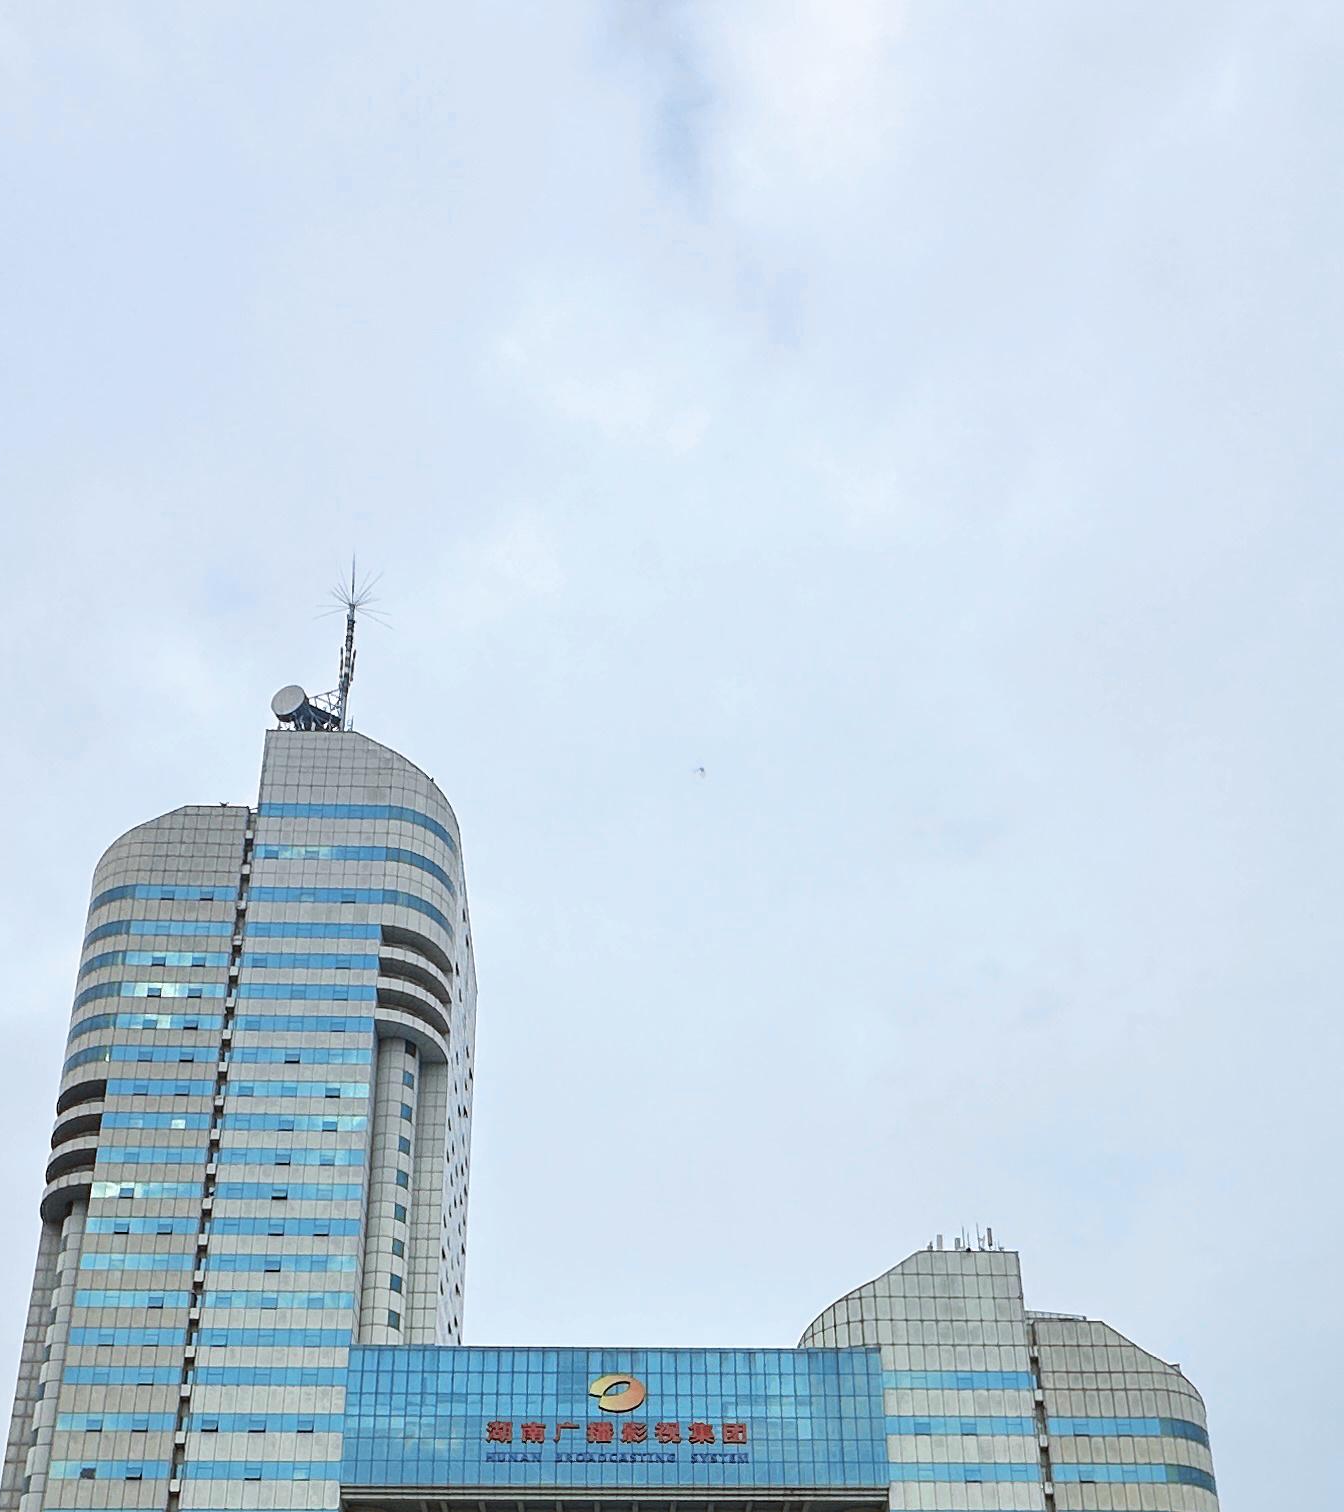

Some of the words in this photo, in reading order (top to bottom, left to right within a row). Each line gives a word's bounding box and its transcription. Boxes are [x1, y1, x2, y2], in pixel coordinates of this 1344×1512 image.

[485, 1421, 747, 1444] 湖南广播影视集团
[486, 1452, 542, 1463] HUNAN
[556, 1452, 676, 1464] BROADCASTING
[690, 1452, 749, 1464] SYSTEM
